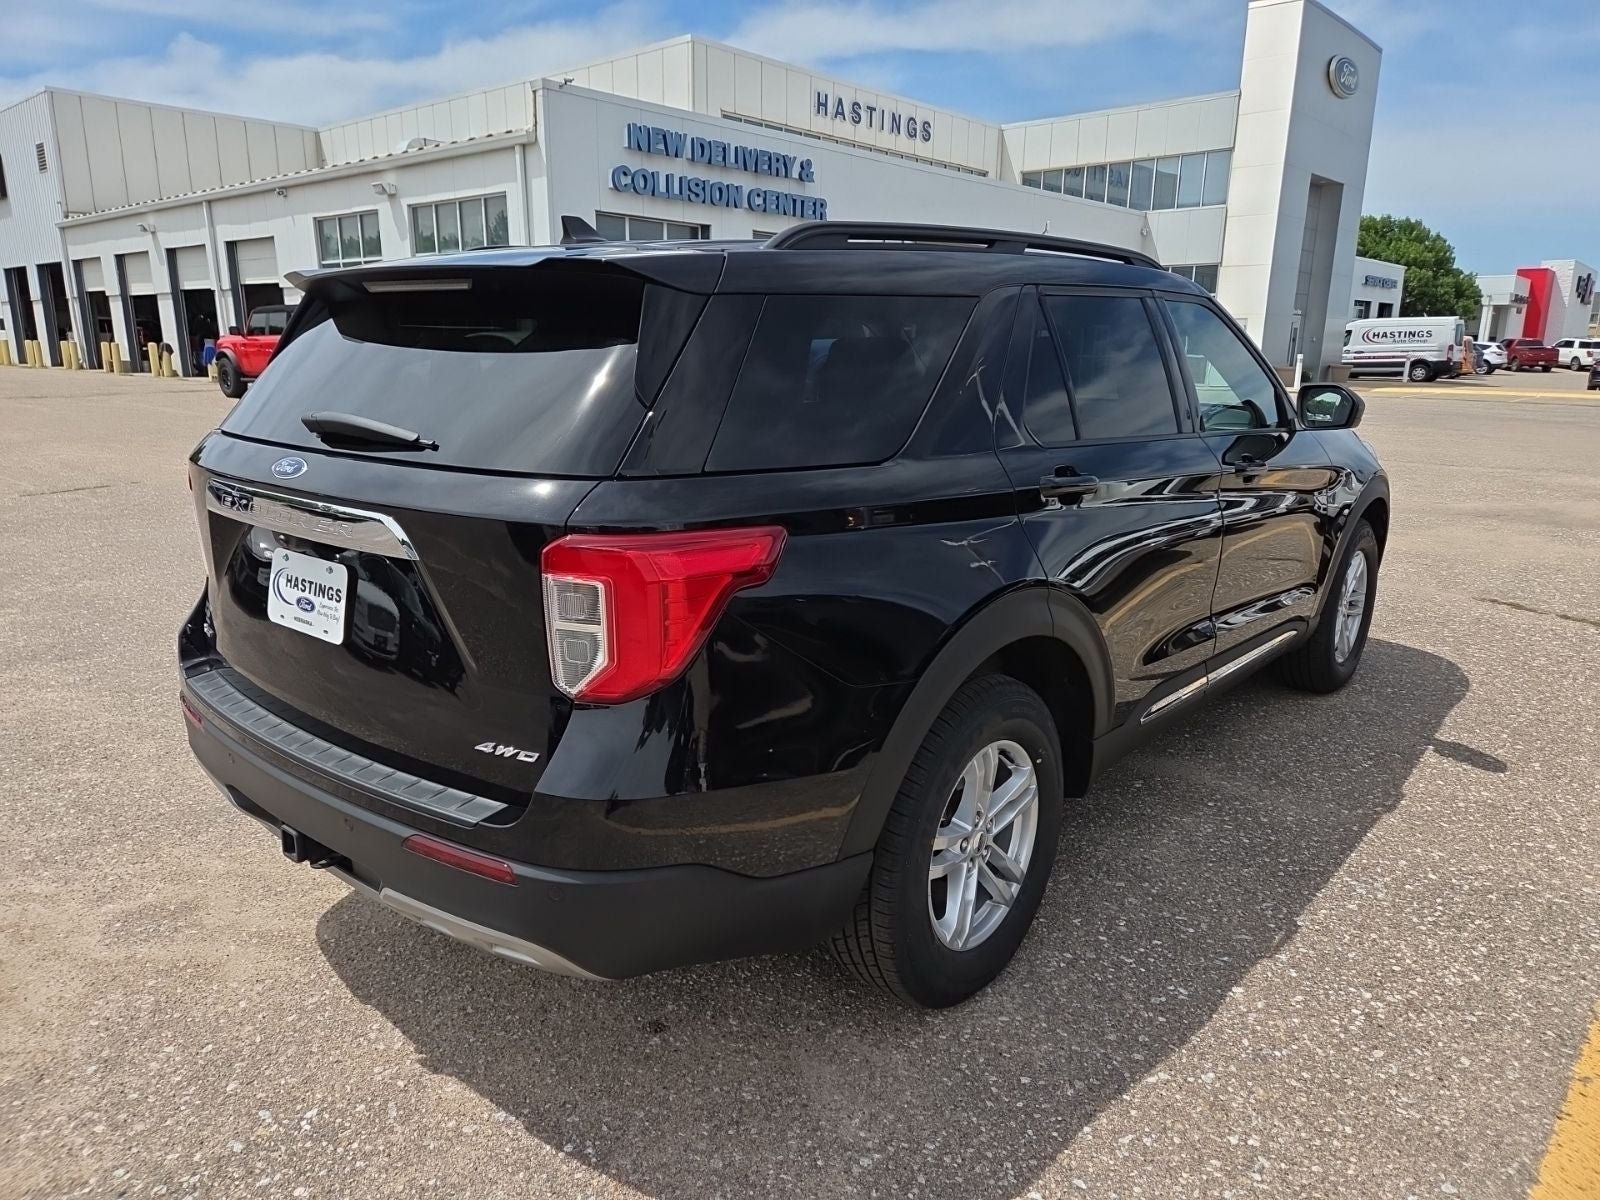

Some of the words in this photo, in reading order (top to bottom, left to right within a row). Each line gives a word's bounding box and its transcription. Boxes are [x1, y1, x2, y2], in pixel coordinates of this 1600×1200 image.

[815, 91, 932, 142] HASTINGS
[626, 122, 688, 158] NEW
[690, 136, 797, 179] DELIVERY
[799, 158, 815, 183] &
[611, 164, 744, 209] COLLISION
[747, 187, 828, 220] CENTER
[1372, 330, 1433, 339] HASTINGS
[285, 573, 342, 604] HASTINGS
[474, 742, 540, 762] 4WD
